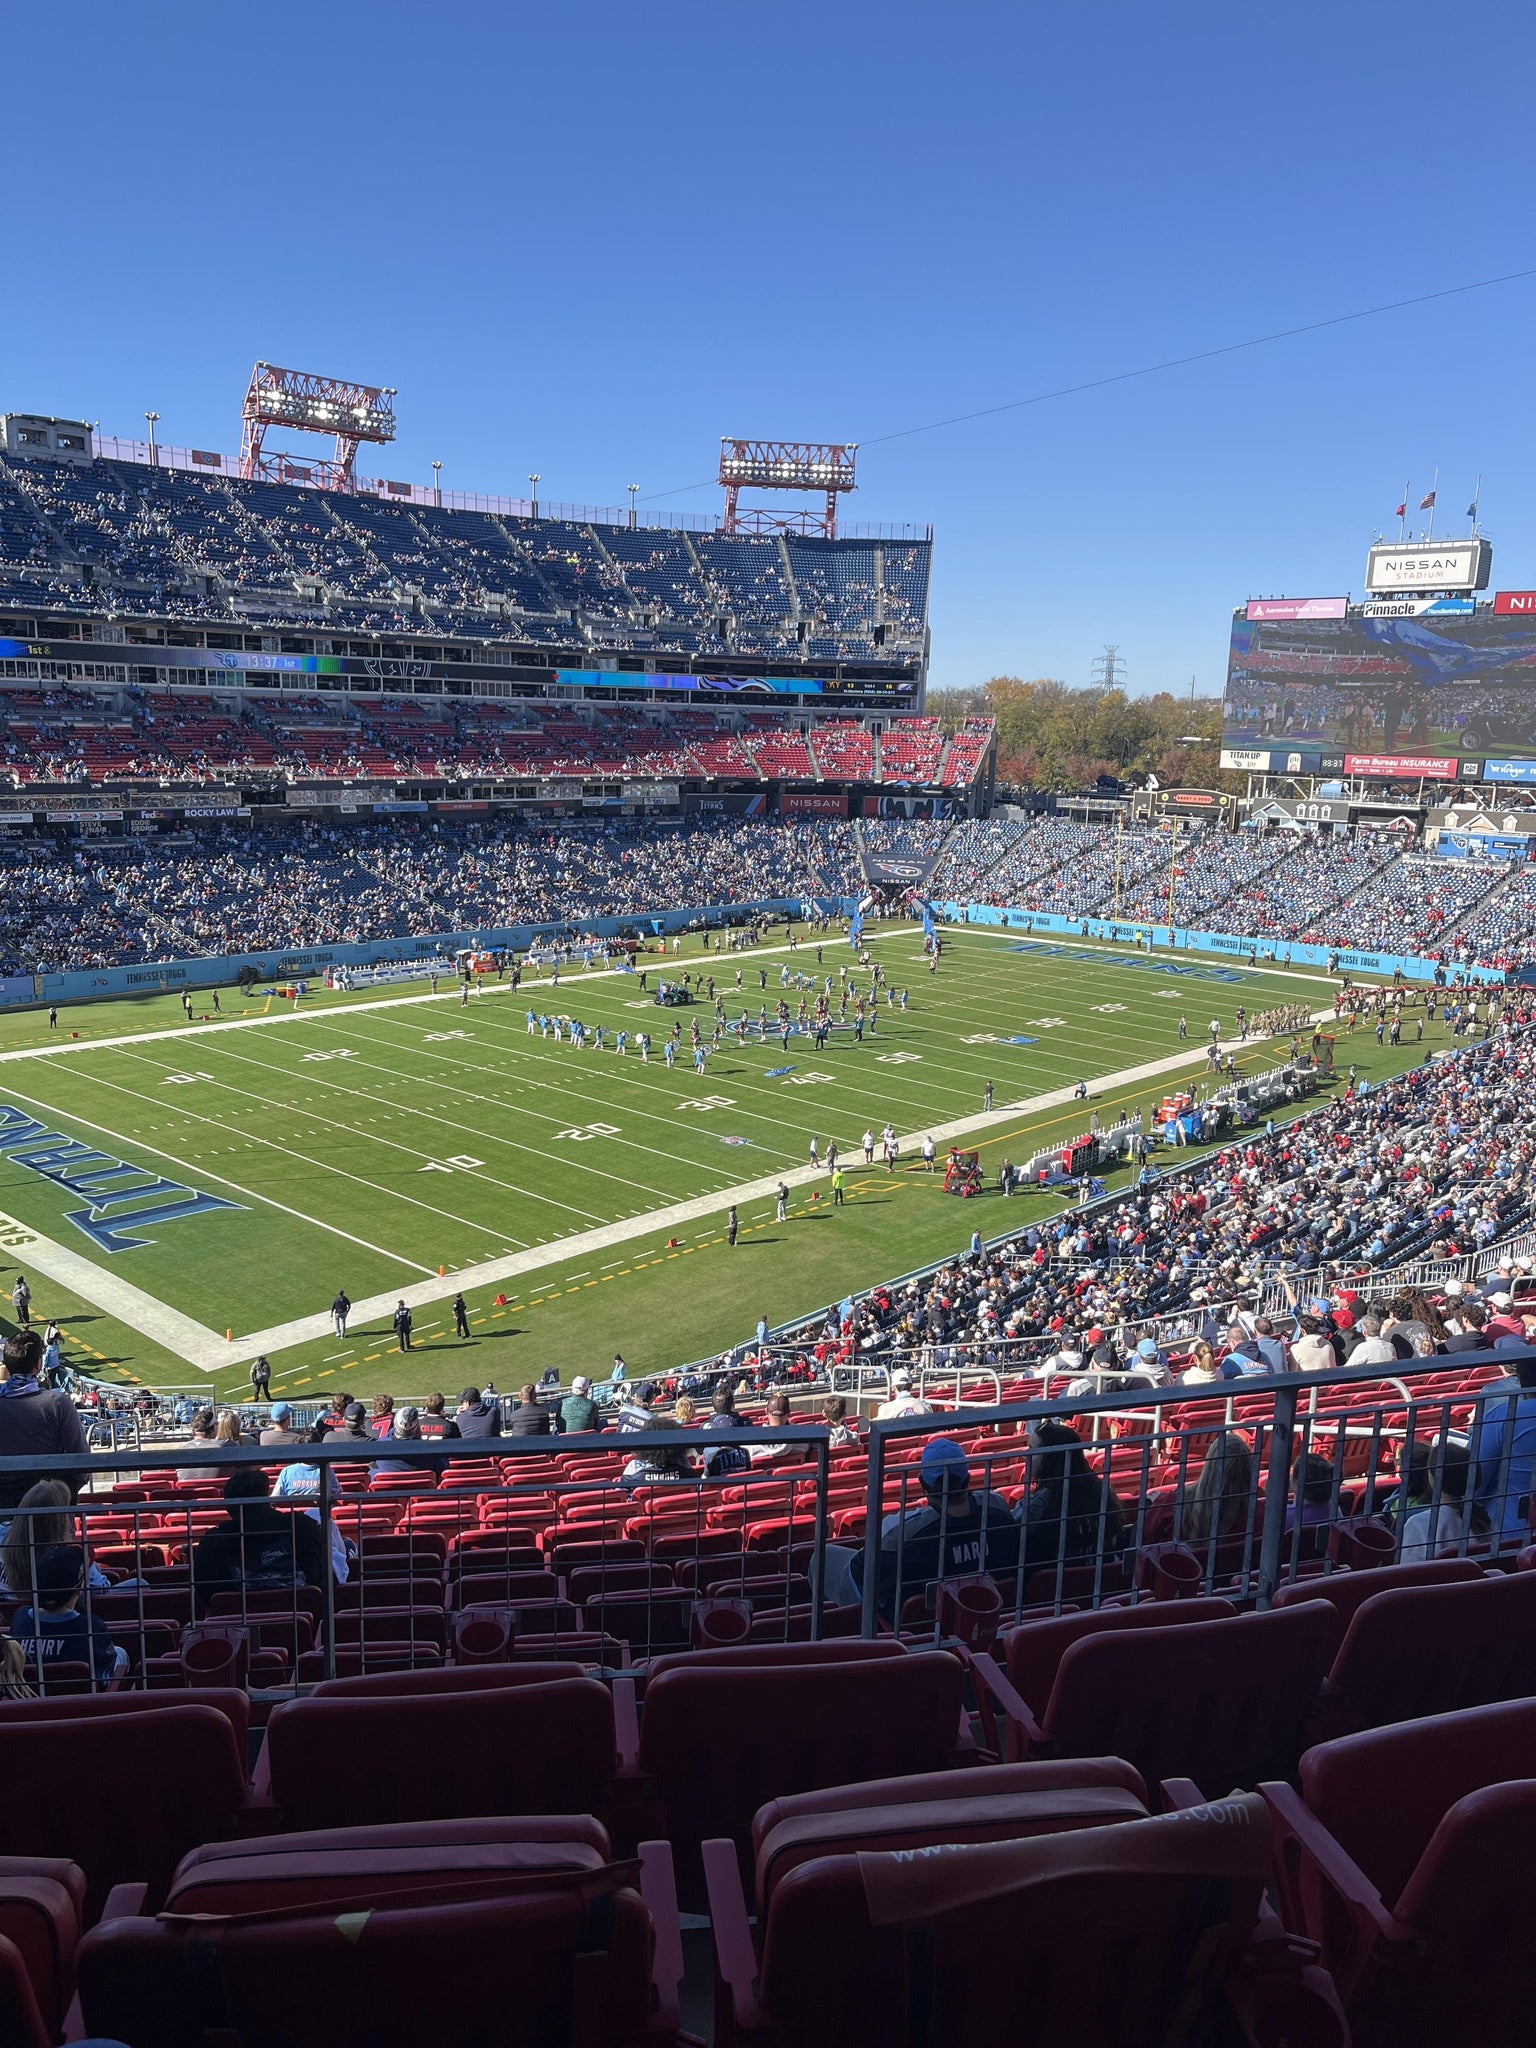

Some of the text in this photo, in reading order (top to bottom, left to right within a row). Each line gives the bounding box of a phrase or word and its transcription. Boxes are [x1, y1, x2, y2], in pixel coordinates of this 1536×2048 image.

[1385, 559, 1457, 571] NISSAN
[1396, 571, 1444, 580] STADIUM
[1365, 603, 1415, 616] Pinnacle
[1510, 597, 1536, 609] NI
[28, 645, 43, 655] 1st
[284, 659, 295, 667] 1st
[1251, 752, 1261, 760] UP
[1351, 757, 1450, 768] Farm Bureau INSURANCE
[1500, 763, 1526, 777] Kroger
[699, 800, 724, 810] TITANS
[790, 799, 840, 807] NISSAN
[141, 810, 165, 819] FedEx
[184, 808, 235, 817] ROCKY LAW
[130, 824, 159, 832] GEORGE
[1210, 937, 1257, 951] TENNESSEE TOUGH
[314, 953, 334, 964] TOUGH
[993, 942, 1264, 983] TITANS
[1360, 957, 1380, 967] TOUGH
[126, 970, 163, 985] TENNESSEE
[1025, 1016, 1068, 1029] 30
[428, 1029, 475, 1042] 30
[960, 1032, 1001, 1045] 40
[305, 1048, 360, 1063] 20
[874, 1050, 924, 1066] 50
[165, 1071, 215, 1086] 10
[790, 1071, 836, 1085] 40
[682, 1094, 738, 1112] 30
[558, 1122, 623, 1142] 20
[427, 1153, 487, 1174] 10
[548, 1375, 556, 1383] A
[372, 1419, 392, 1439] 7
[645, 1470, 680, 1482] SIMMONS
[20, 1639, 65, 1656] HENRY
